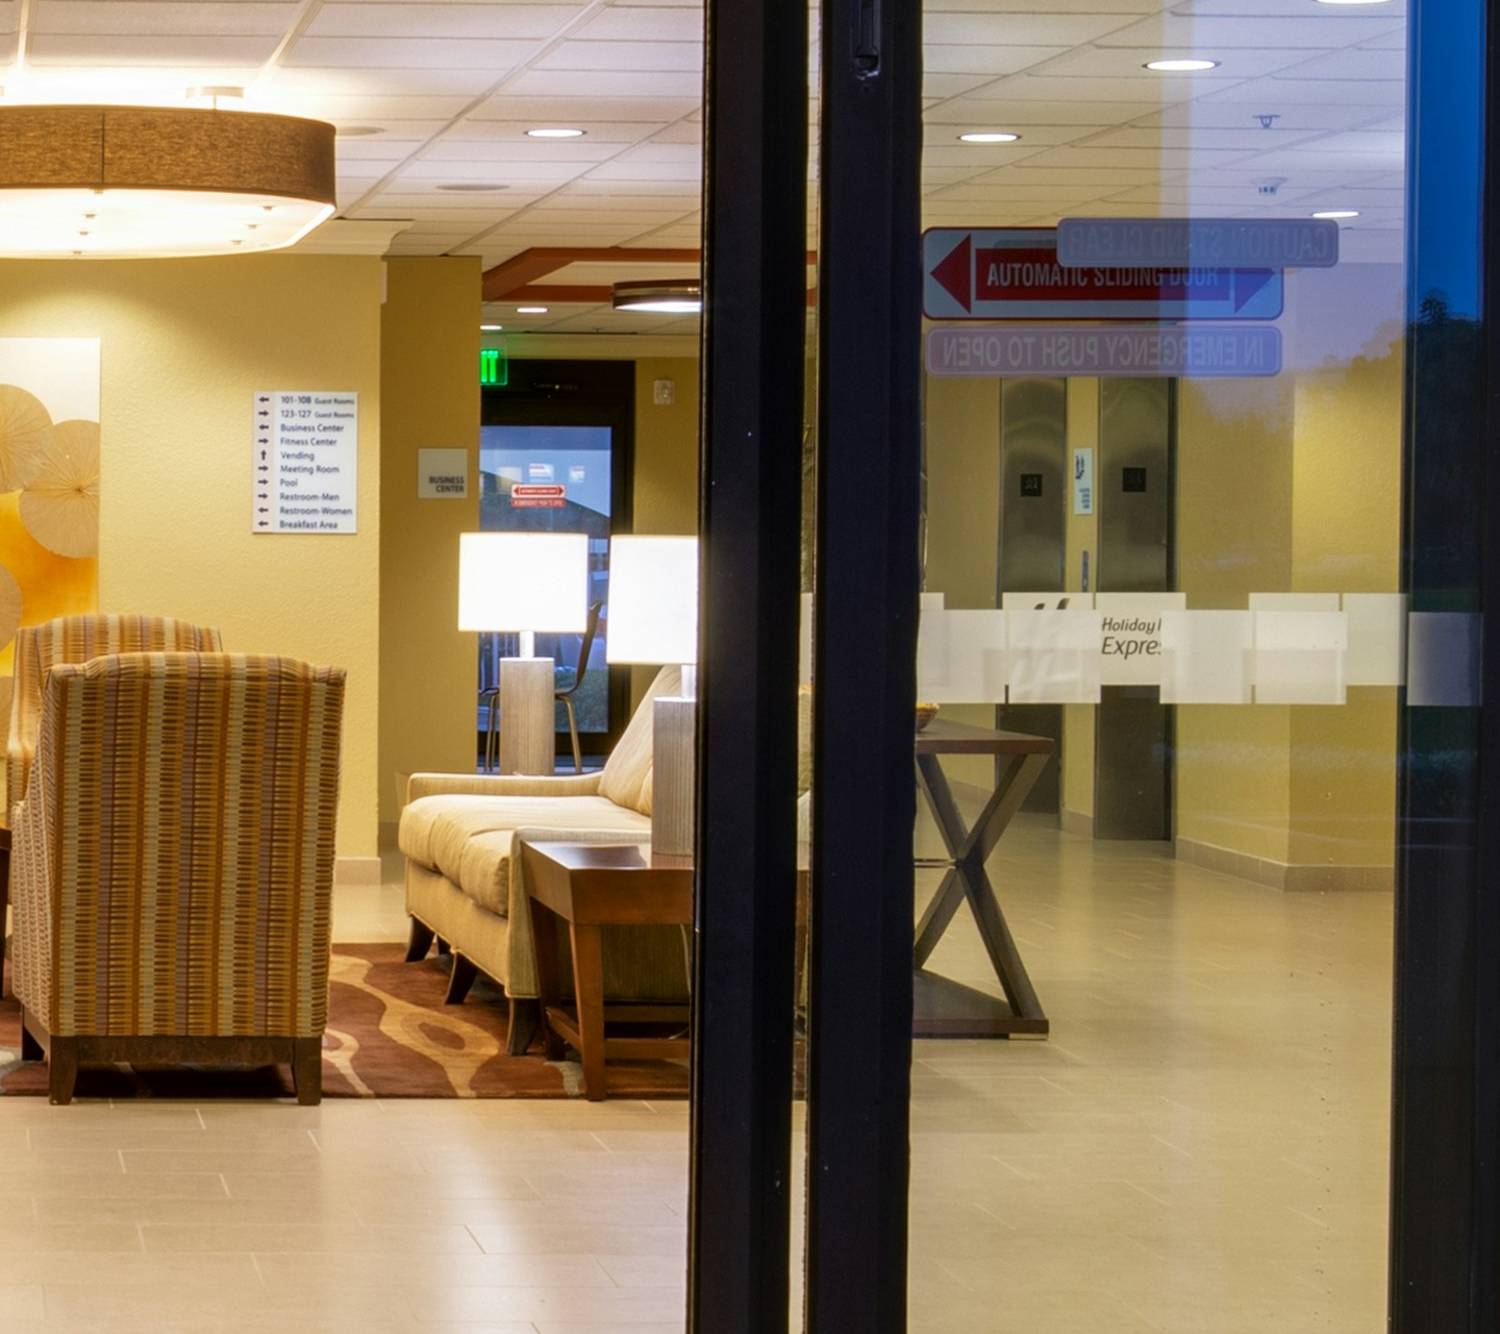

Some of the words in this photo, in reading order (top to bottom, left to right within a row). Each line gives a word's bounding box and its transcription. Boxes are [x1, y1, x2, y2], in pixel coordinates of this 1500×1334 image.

[987, 263, 1088, 287] AUTOMATIC
[1094, 266, 1164, 287] SLIDING
[480, 350, 499, 383] IT
[281, 395, 311, 404] 101-108
[281, 409, 312, 418] 123-127
[280, 423, 315, 432] Business
[317, 423, 344, 432] Center
[280, 437, 308, 446] Fitness
[310, 437, 337, 446] Center
[280, 451, 315, 462] Vending
[280, 465, 314, 475] Meeting
[316, 465, 340, 473] Room
[280, 478, 298, 486] Pool
[429, 476, 464, 484] BUSINESS
[435, 485, 464, 493] CENTER
[280, 492, 340, 501] Restroom-Men
[280, 506, 353, 515] Restroom-Women
[279, 520, 317, 529] Breakfast
[319, 520, 338, 529] Area
[1102, 617, 1156, 635] Holiday
[1101, 636, 1162, 660] Expre
